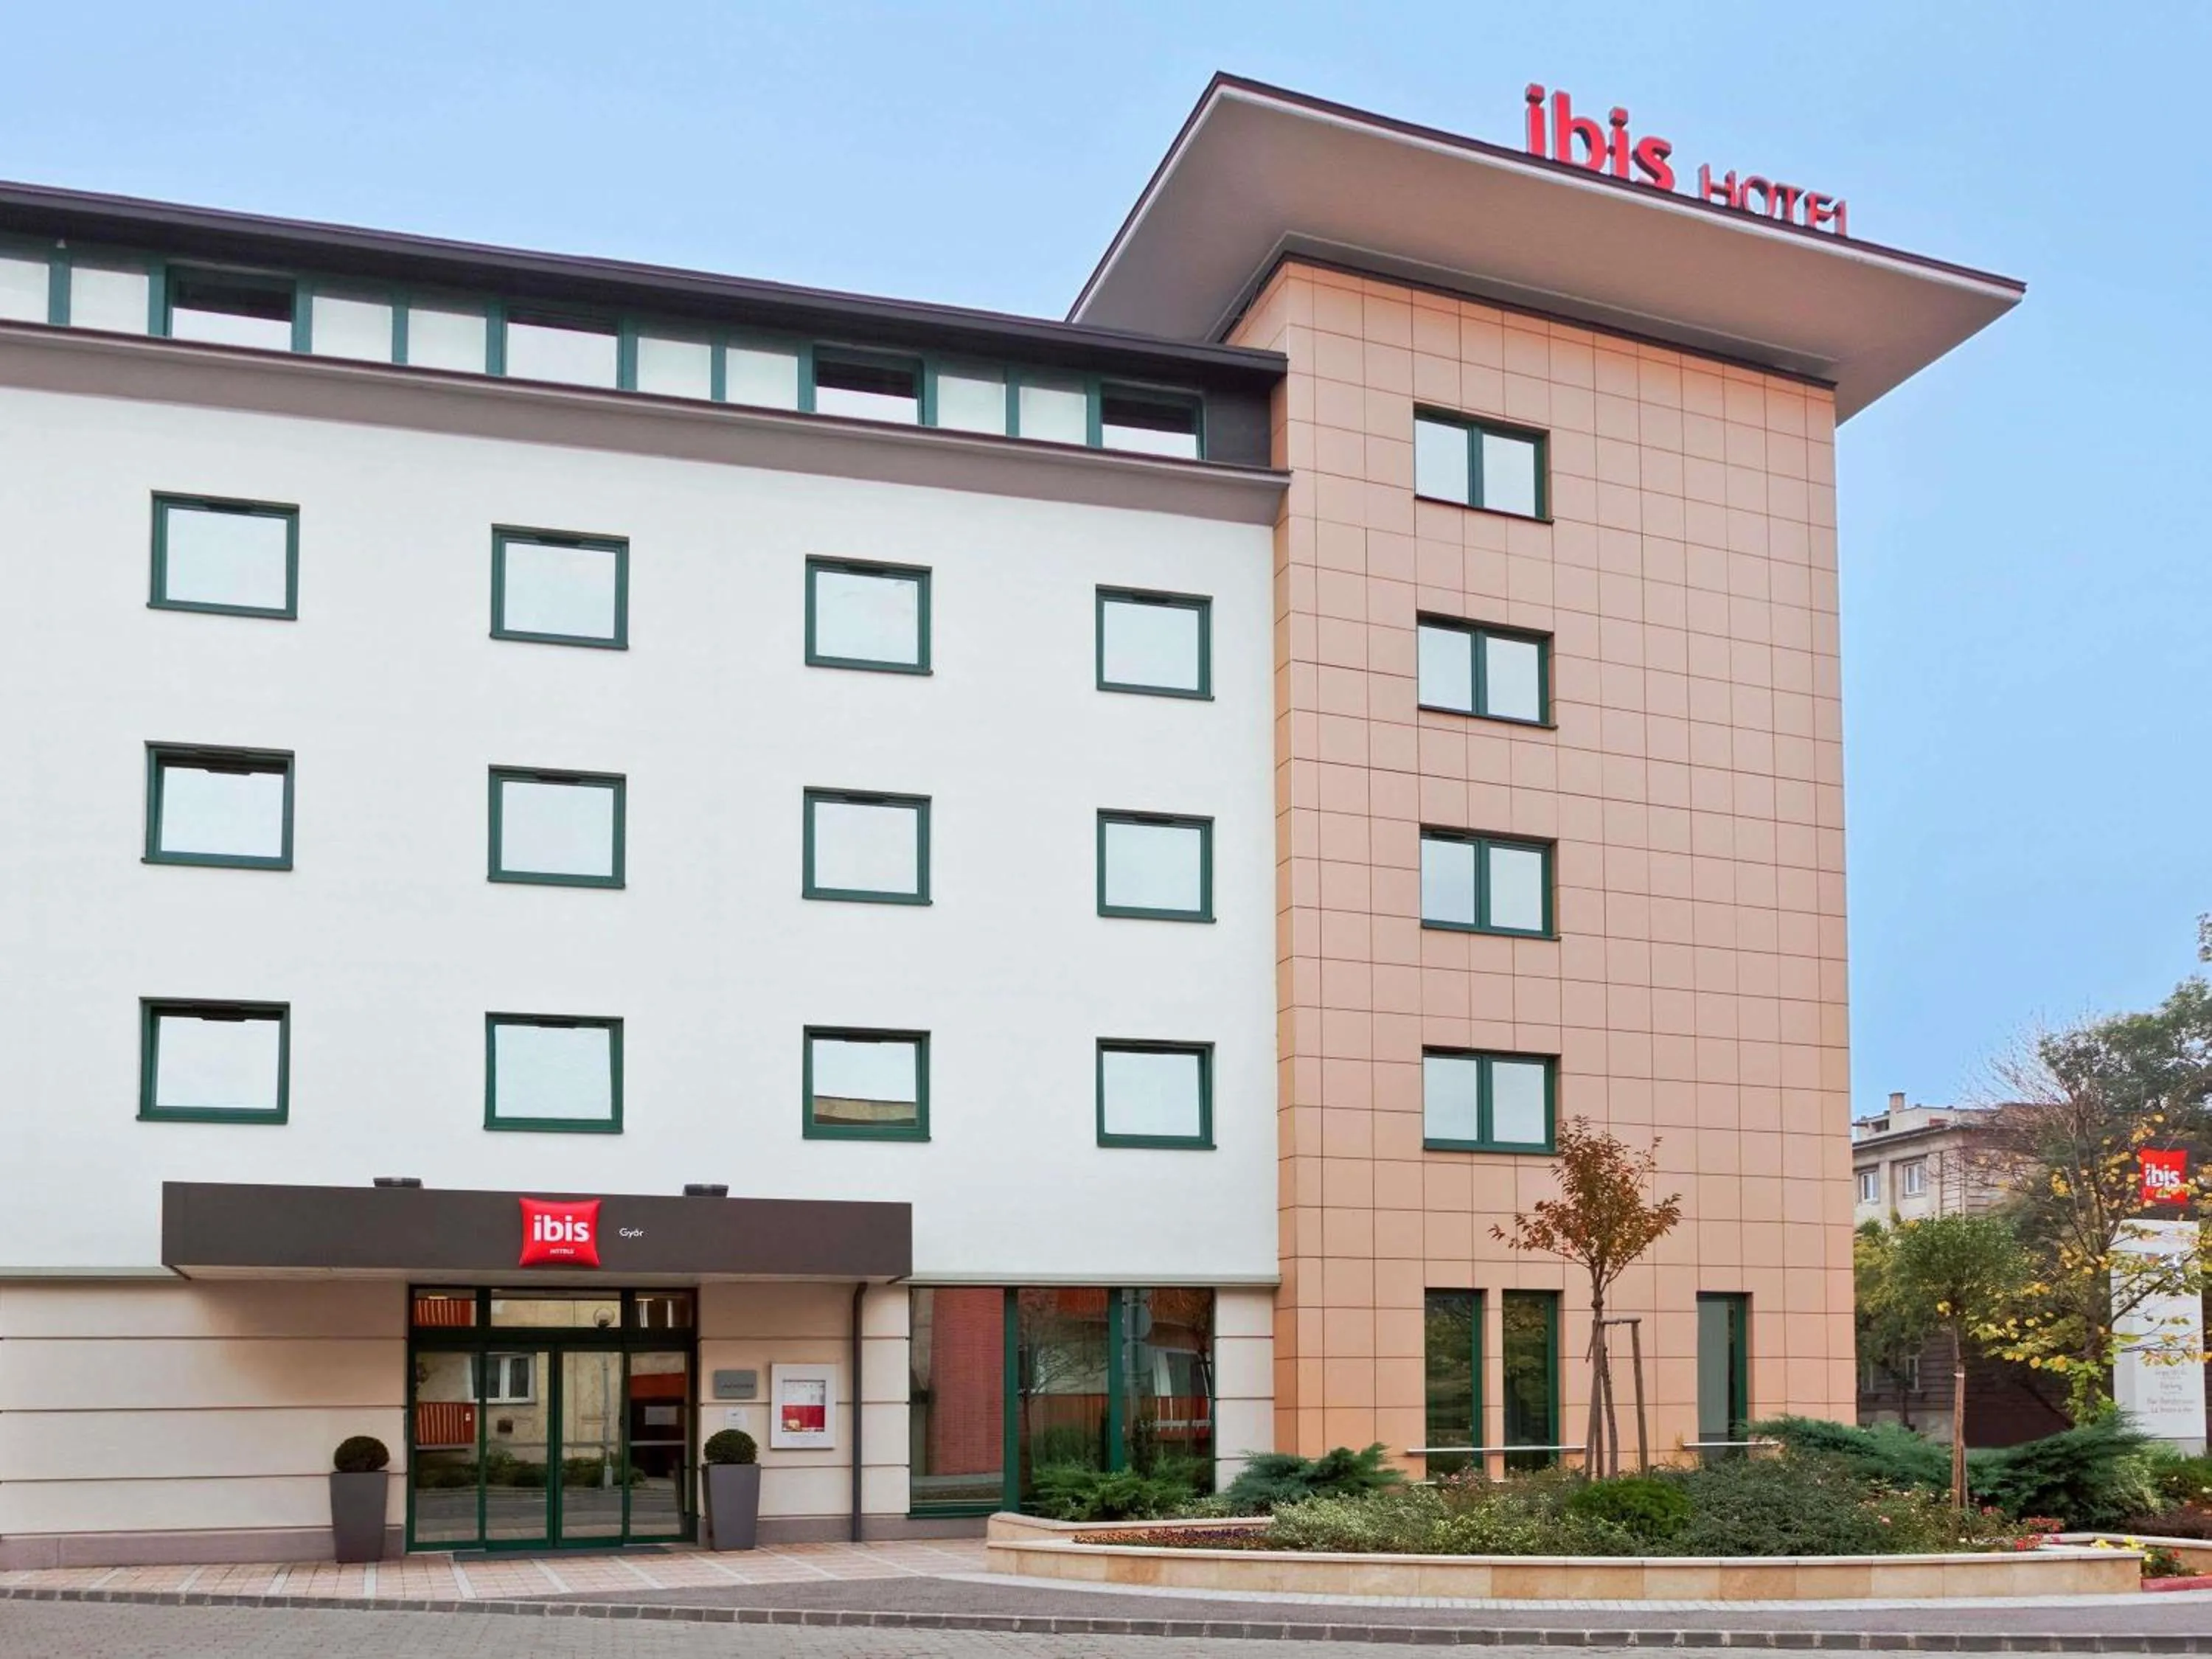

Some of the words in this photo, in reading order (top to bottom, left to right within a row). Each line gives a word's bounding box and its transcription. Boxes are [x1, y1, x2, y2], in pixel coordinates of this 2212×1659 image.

[1525, 83, 1675, 192] ibis
[2145, 1162, 2180, 1188] ibis
[533, 1214, 590, 1242] ibis
